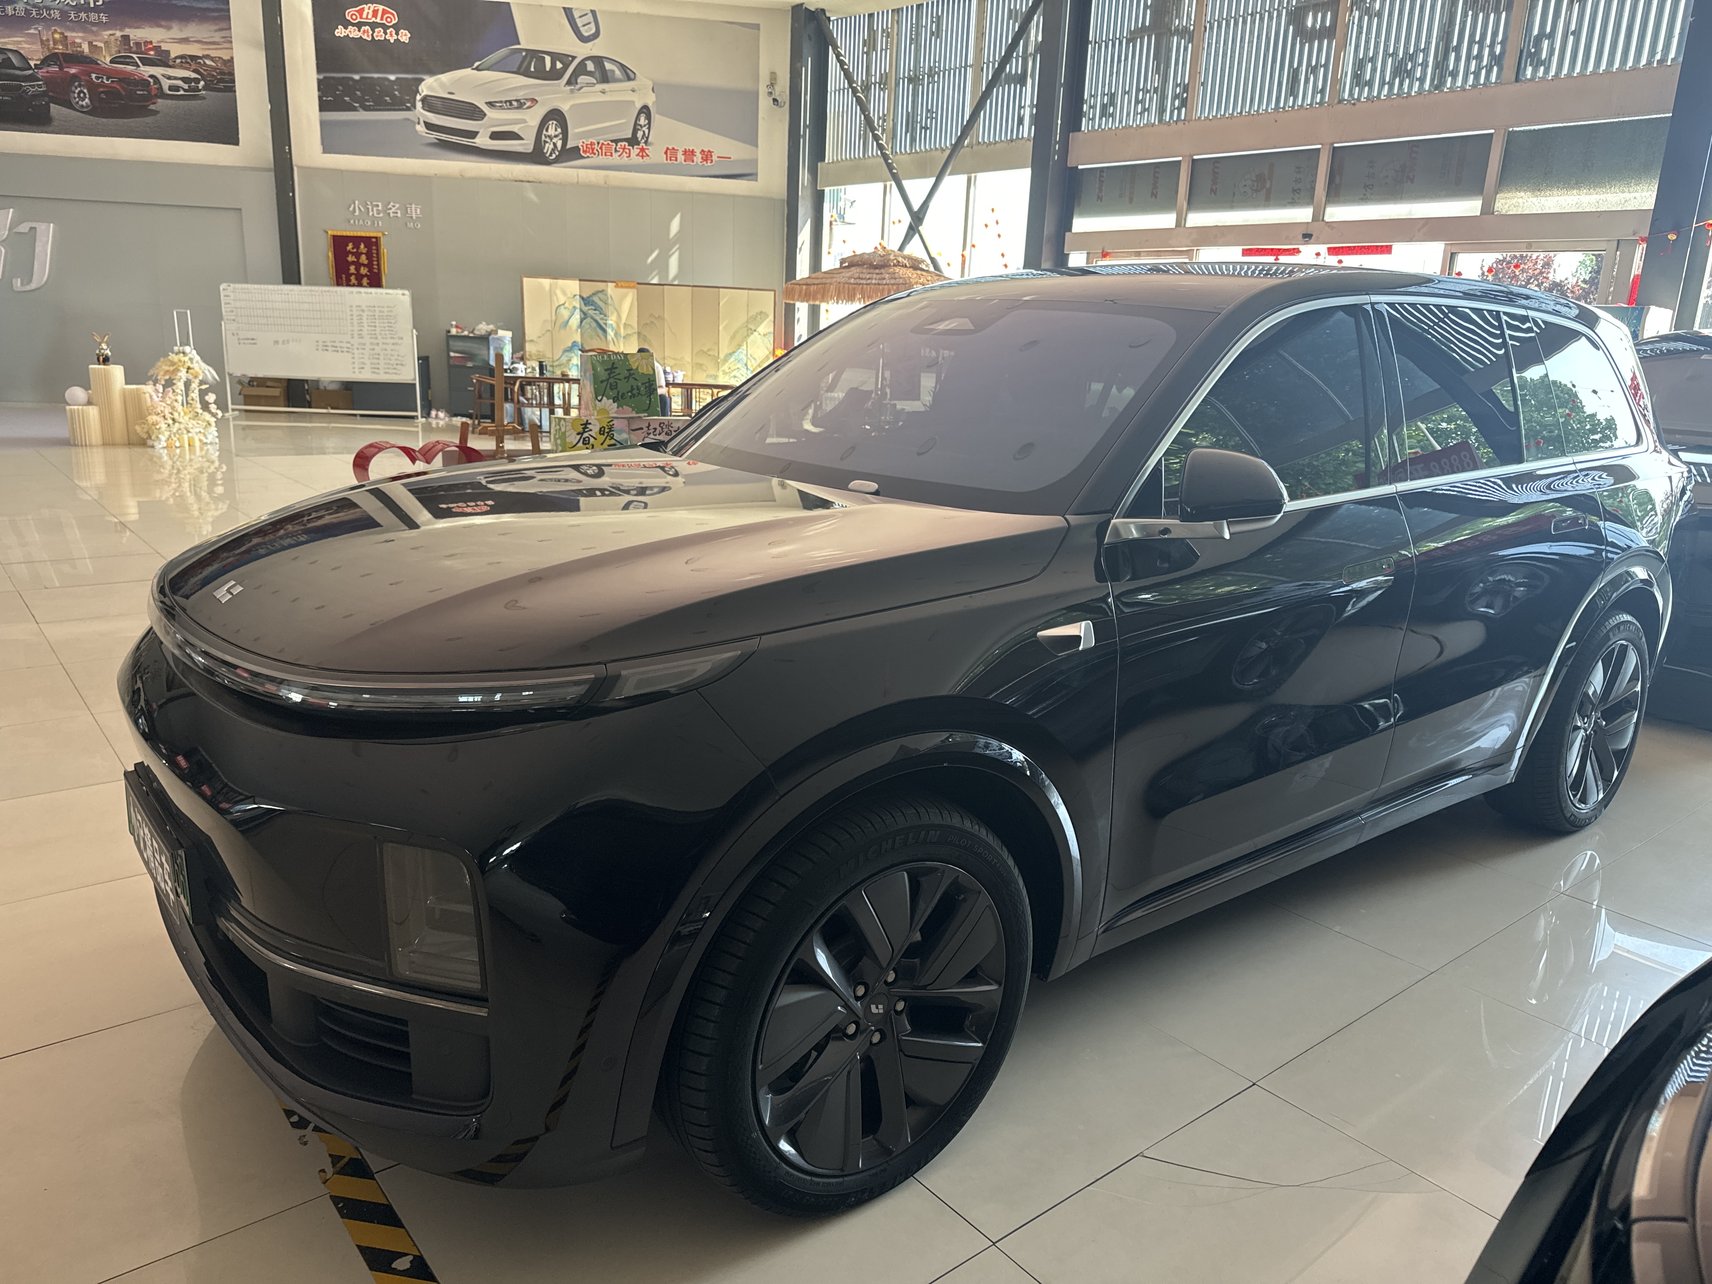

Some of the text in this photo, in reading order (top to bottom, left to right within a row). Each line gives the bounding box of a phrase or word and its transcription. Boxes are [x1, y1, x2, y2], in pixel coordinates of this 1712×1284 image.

[30, 8, 62, 20] 无火烧
[67, 11, 110, 24] 无水泡车
[334, 24, 412, 44] 小记精品车行
[579, 140, 732, 165] 诚信为本 信誉第一
[349, 199, 424, 220] 小记名車
[596, 362, 638, 403] 春天
[568, 419, 625, 449] 春暖
[838, 829, 941, 880] MICHELIN
